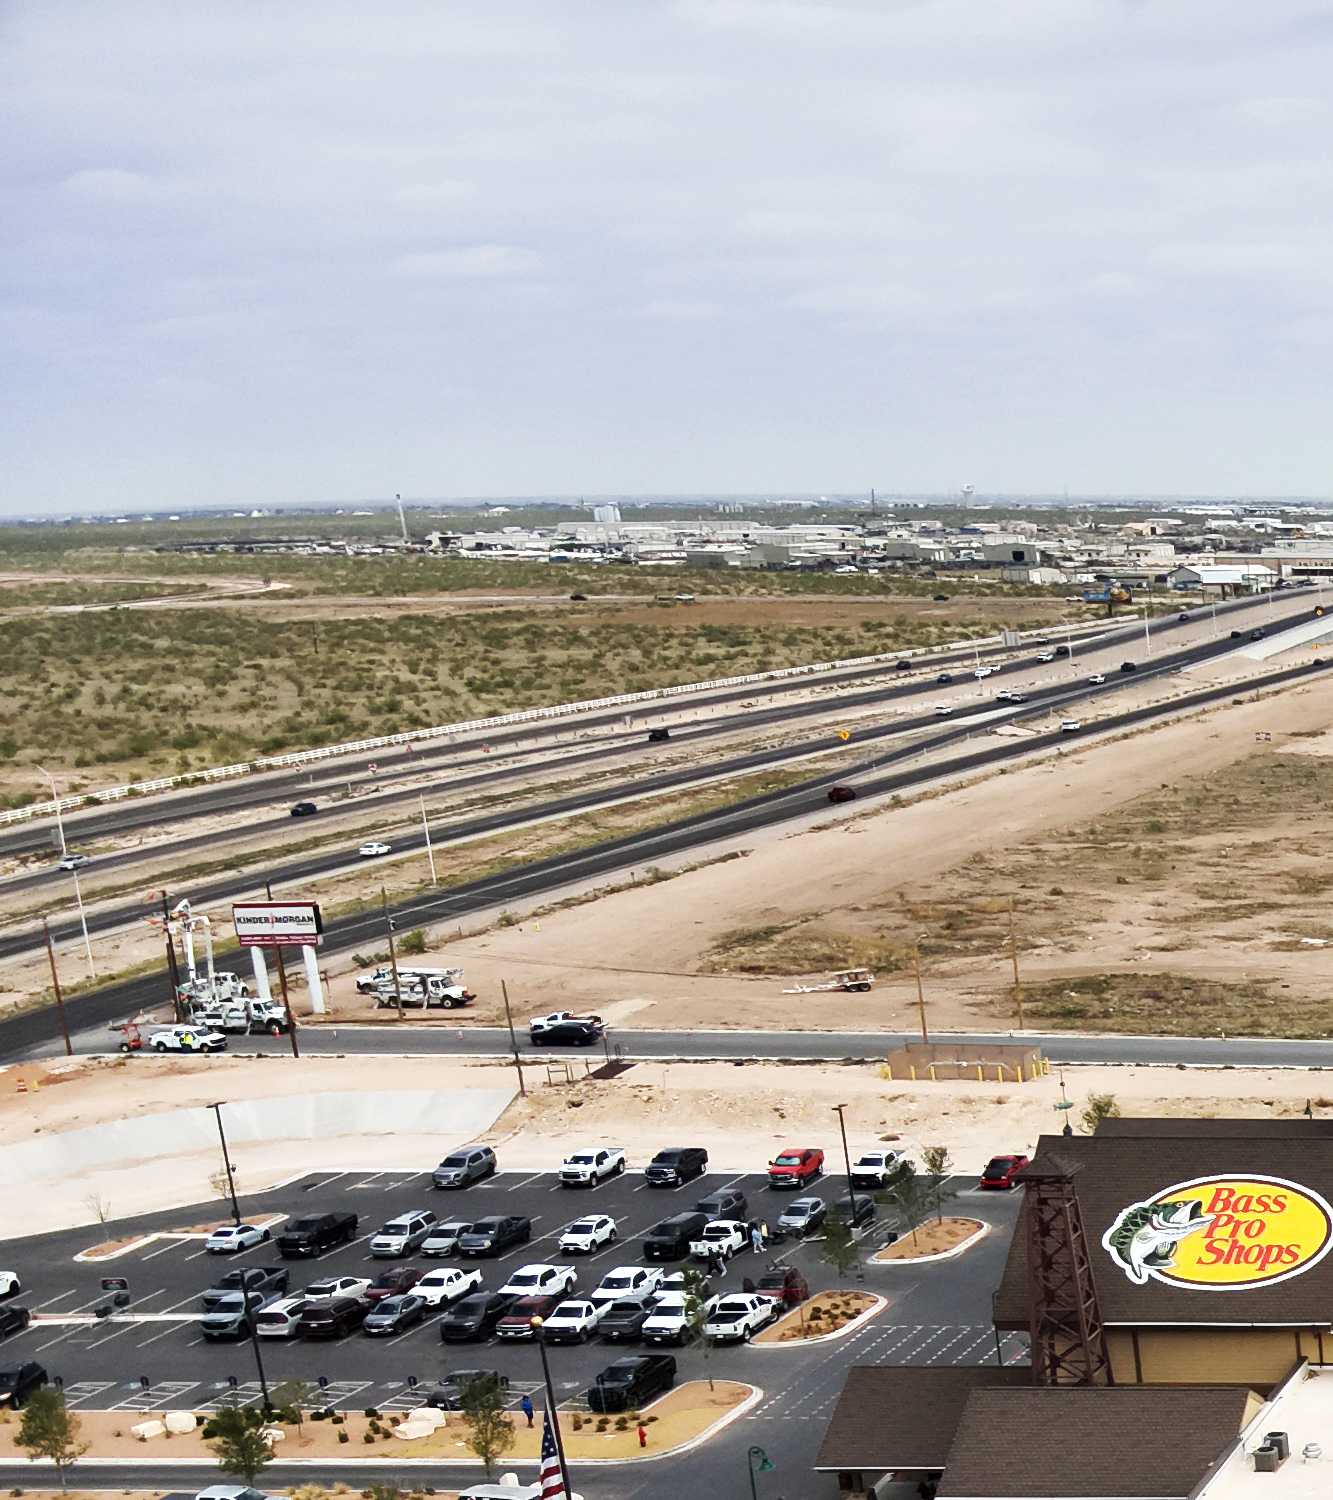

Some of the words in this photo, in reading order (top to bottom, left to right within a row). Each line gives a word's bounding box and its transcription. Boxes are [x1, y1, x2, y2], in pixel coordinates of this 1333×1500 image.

[274, 915, 314, 923] MORGAN
[1204, 1187, 1288, 1214] Bass
[1202, 1213, 1266, 1239] Pro
[1196, 1238, 1301, 1272] Shops
